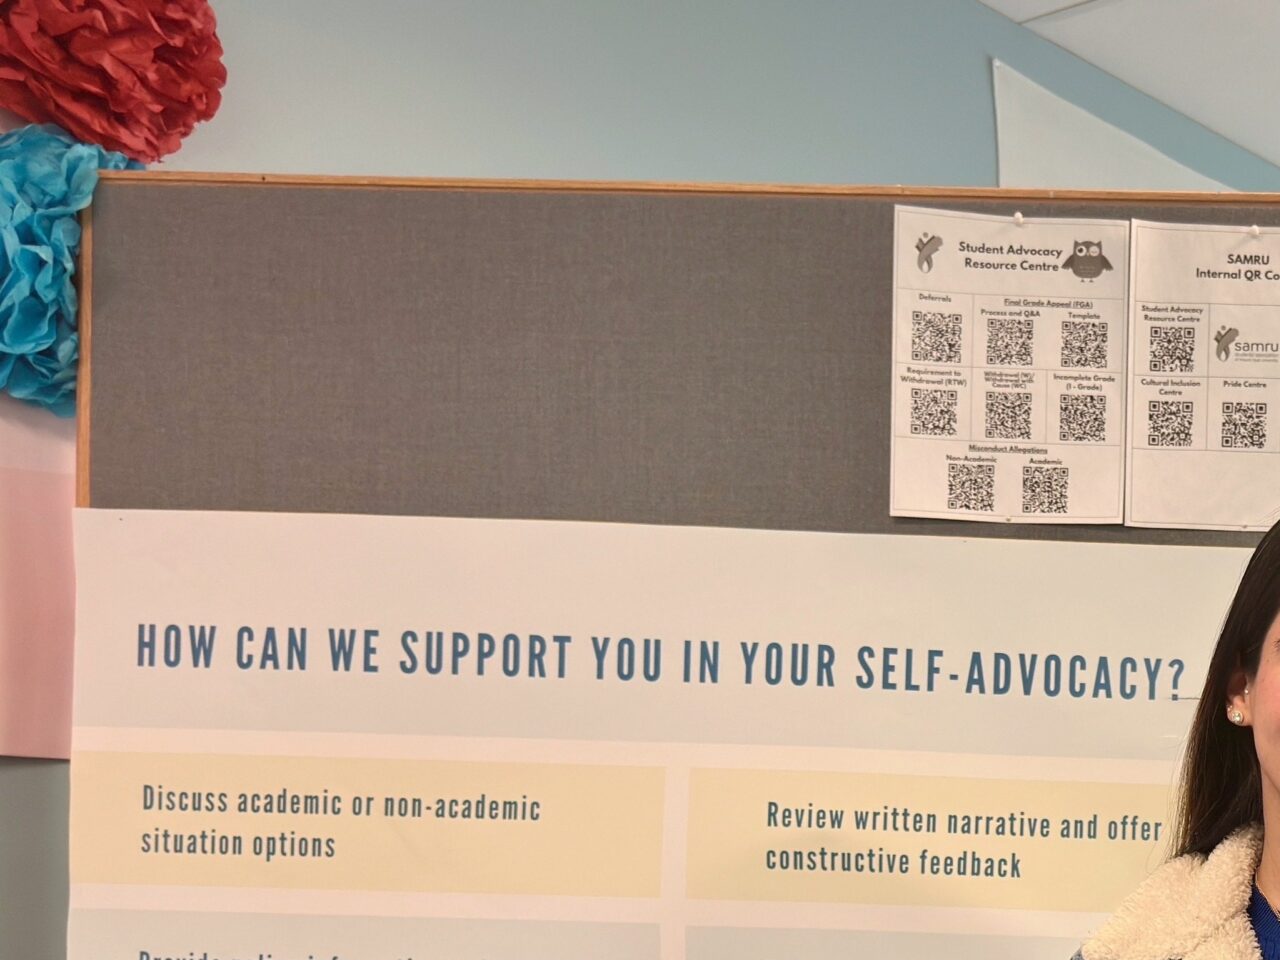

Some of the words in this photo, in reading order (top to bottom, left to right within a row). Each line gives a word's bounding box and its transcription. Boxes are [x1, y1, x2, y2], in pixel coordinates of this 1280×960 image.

[959, 242, 1004, 255] Student
[1007, 244, 1063, 259] Advocacy
[1227, 254, 1270, 265] SAMRU
[965, 259, 1017, 270] Resource
[1021, 261, 1059, 271] Centre
[1196, 268, 1241, 280] Internal
[1244, 270, 1261, 281] QR
[1234, 341, 1279, 352] samru
[137, 624, 217, 668] HOW
[236, 626, 307, 670] CAN
[328, 629, 379, 672] WE
[399, 631, 571, 678] SUPPORT
[591, 637, 662, 681] YOU
[683, 640, 719, 683] IN
[741, 642, 836, 688] YOUR
[856, 646, 1185, 701] SELF-ADVOCACY?
[143, 785, 228, 812] Discuss
[238, 788, 342, 815] academic
[352, 797, 374, 816] or
[384, 795, 541, 821] non-academic
[767, 802, 844, 829] Review
[854, 807, 937, 833] written
[948, 812, 1050, 837] narrative
[1061, 816, 1097, 839] and
[1108, 816, 1162, 841] offer
[141, 829, 242, 855] situation
[252, 832, 335, 861] options
[766, 848, 910, 874] constructive
[920, 850, 1022, 878] feedback
